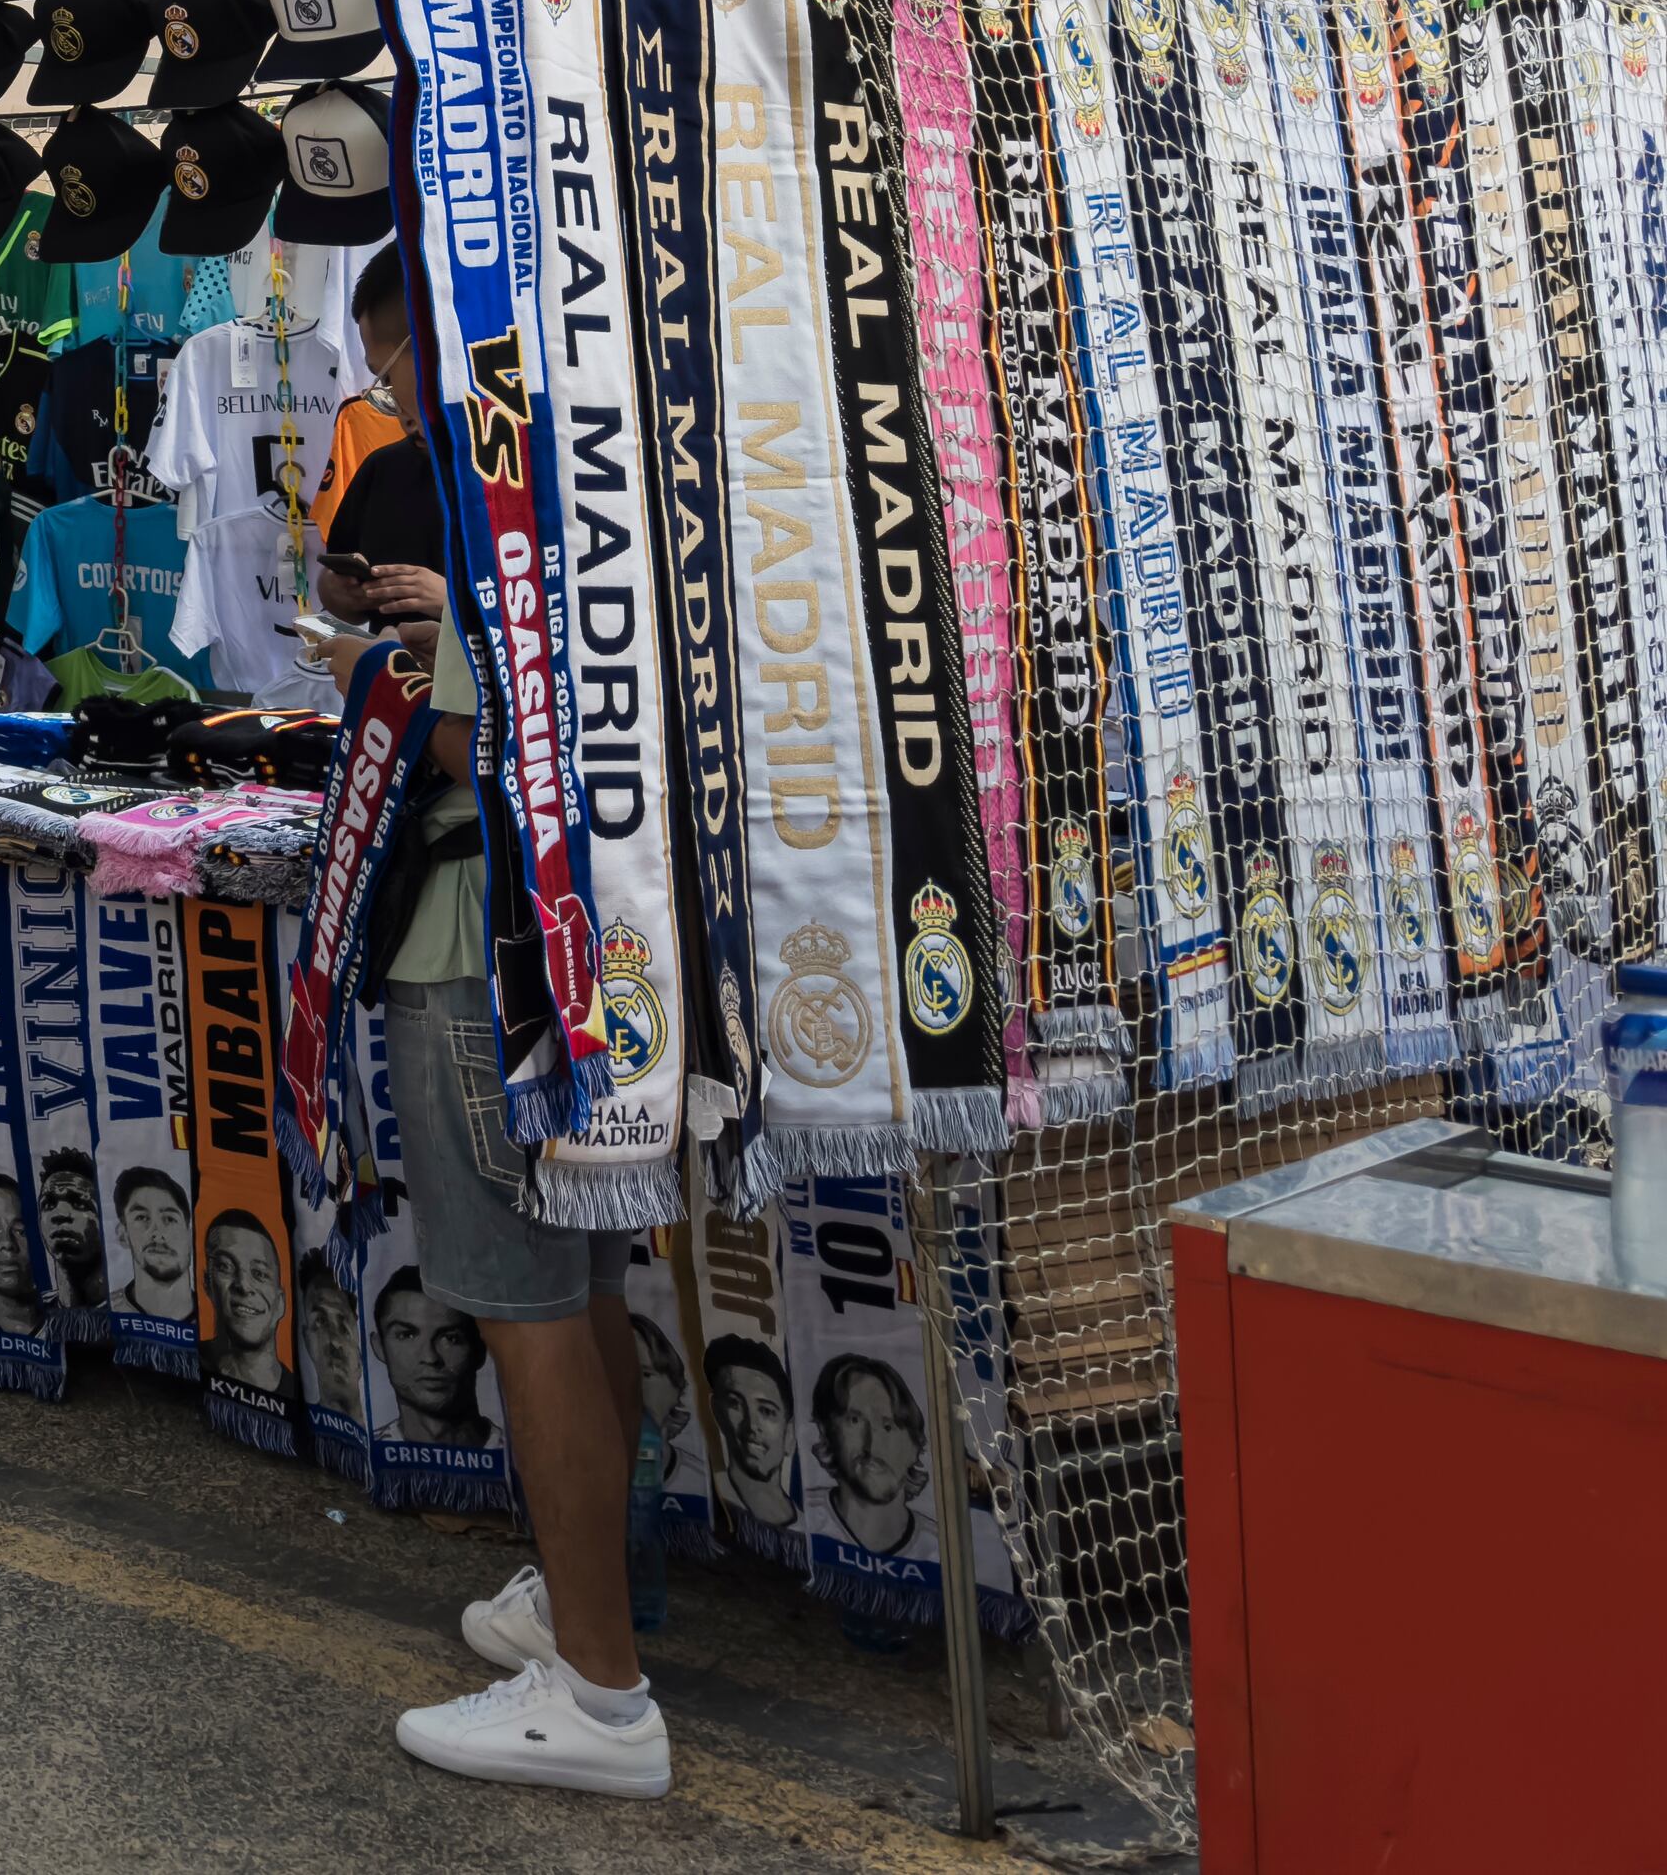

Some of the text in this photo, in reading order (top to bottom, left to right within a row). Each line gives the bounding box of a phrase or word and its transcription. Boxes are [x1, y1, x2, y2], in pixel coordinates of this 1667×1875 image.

[415, 57, 440, 197] BERNABÉU
[505, 154, 534, 297] NACIONAL
[464, 325, 533, 490] VS
[546, 97, 645, 840] REAL MADRID
[627, 106, 729, 836] REAL MADRID
[713, 83, 841, 851] REAL MADRID
[821, 101, 943, 787] REAL MADRID
[999, 133, 1092, 725] REAL MADRID
[1002, 307, 1022, 392] CLUB
[1085, 192, 1196, 720] REAL MADRID
[1152, 157, 1263, 789] REAL MADRID
[1230, 160, 1332, 776] REAL MADRID
[475, 575, 528, 829] 19 AGOSTO 2025
[497, 531, 562, 862] OSASUNA
[541, 543, 582, 827] DE LIGA 2025/2026
[938, 403, 1004, 790] MADRID
[313, 716, 393, 977] OSASUNA
[319, 761, 346, 858] AGOSTO
[339, 726, 353, 754] 19
[331, 757, 407, 987] DE LIGA 2025/2026
[156, 921, 190, 1113] MADRID
[817, 1221, 896, 1314] 10
[210, 1379, 287, 1415] KYLIAN
[383, 1445, 495, 1471] CRISTIANO
[835, 1543, 927, 1582] LUKA
